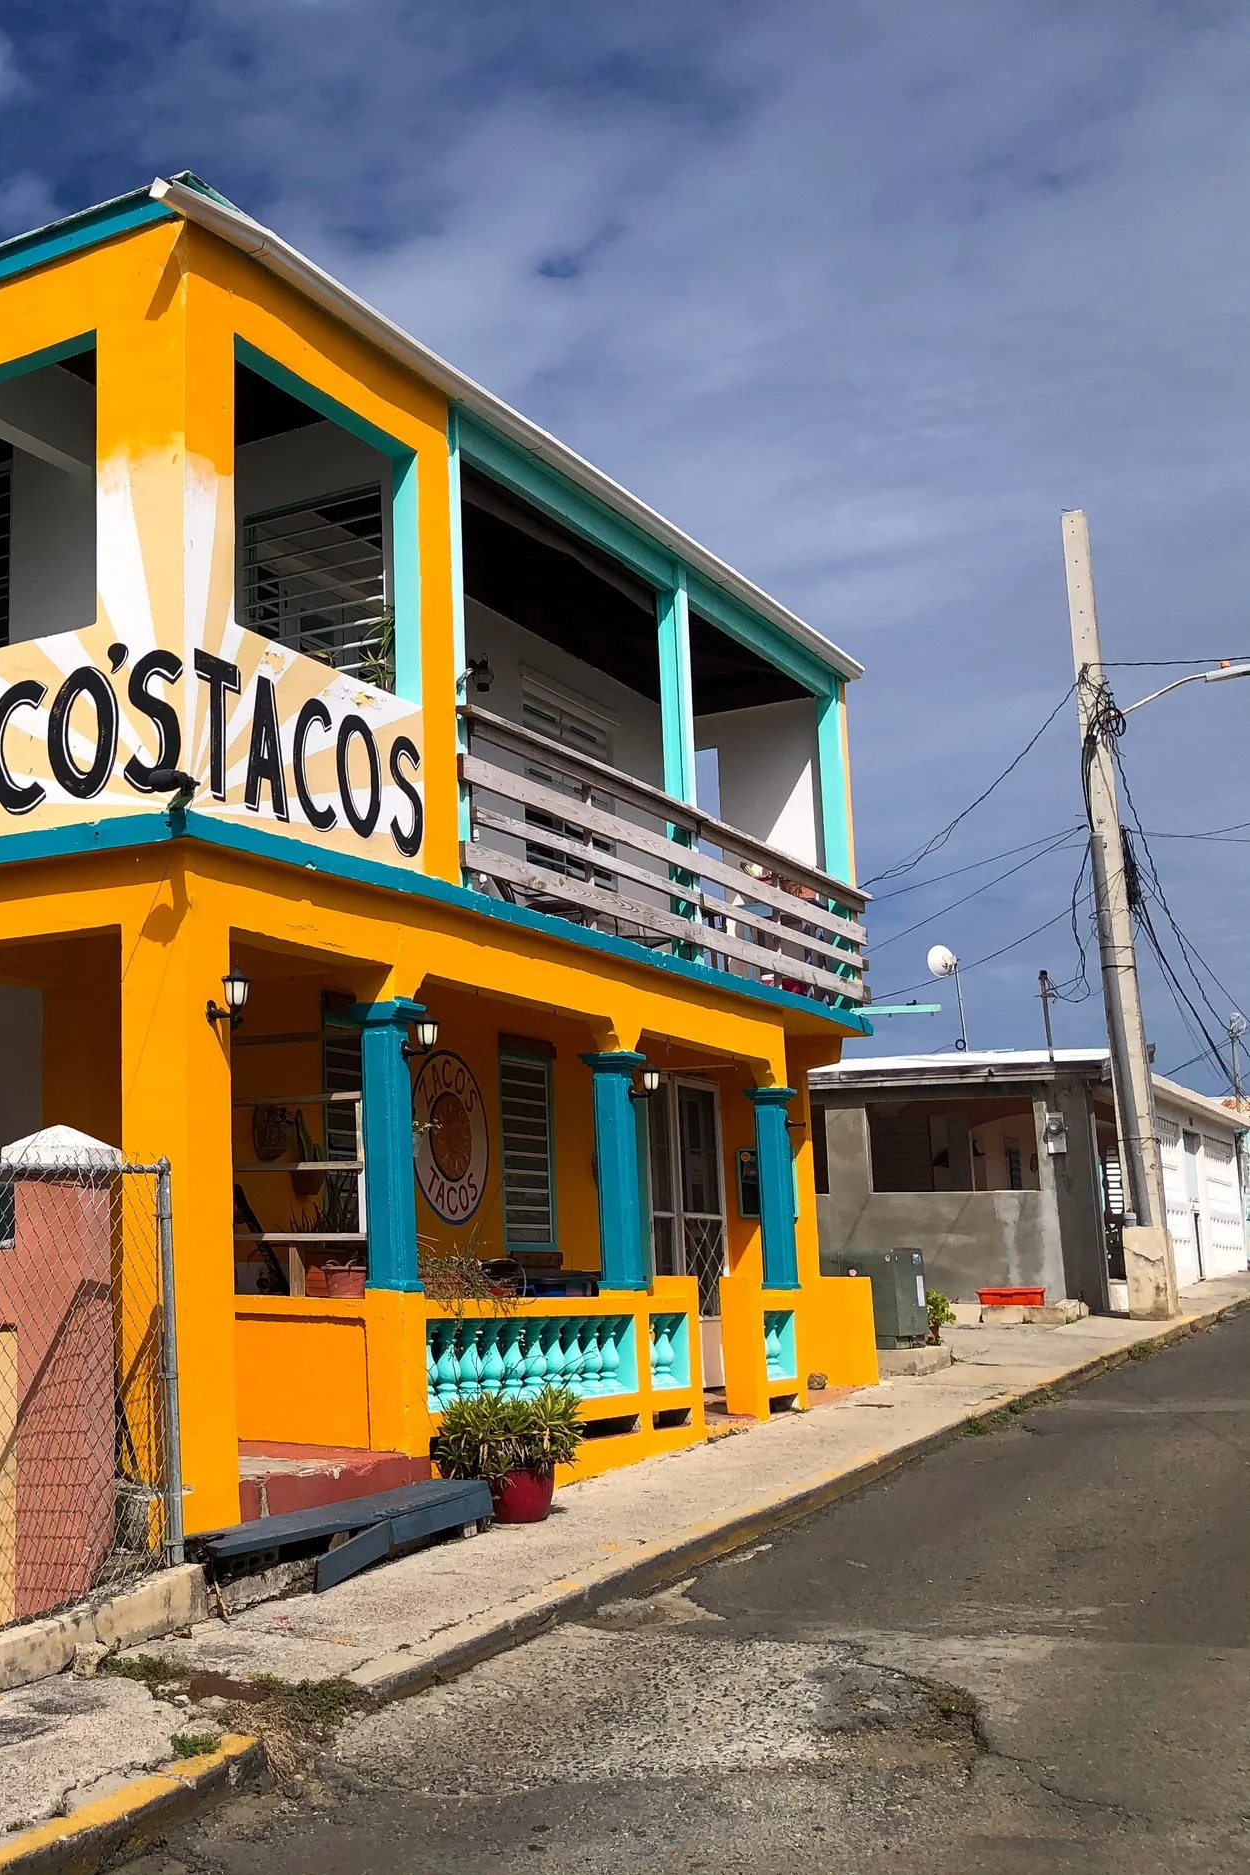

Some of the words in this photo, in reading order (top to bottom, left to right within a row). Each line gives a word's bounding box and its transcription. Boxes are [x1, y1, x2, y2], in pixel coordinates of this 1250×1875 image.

[194, 648, 423, 857] TACOS
[418, 1059, 478, 1113] ZACO'S
[427, 1164, 478, 1216] TACOS
